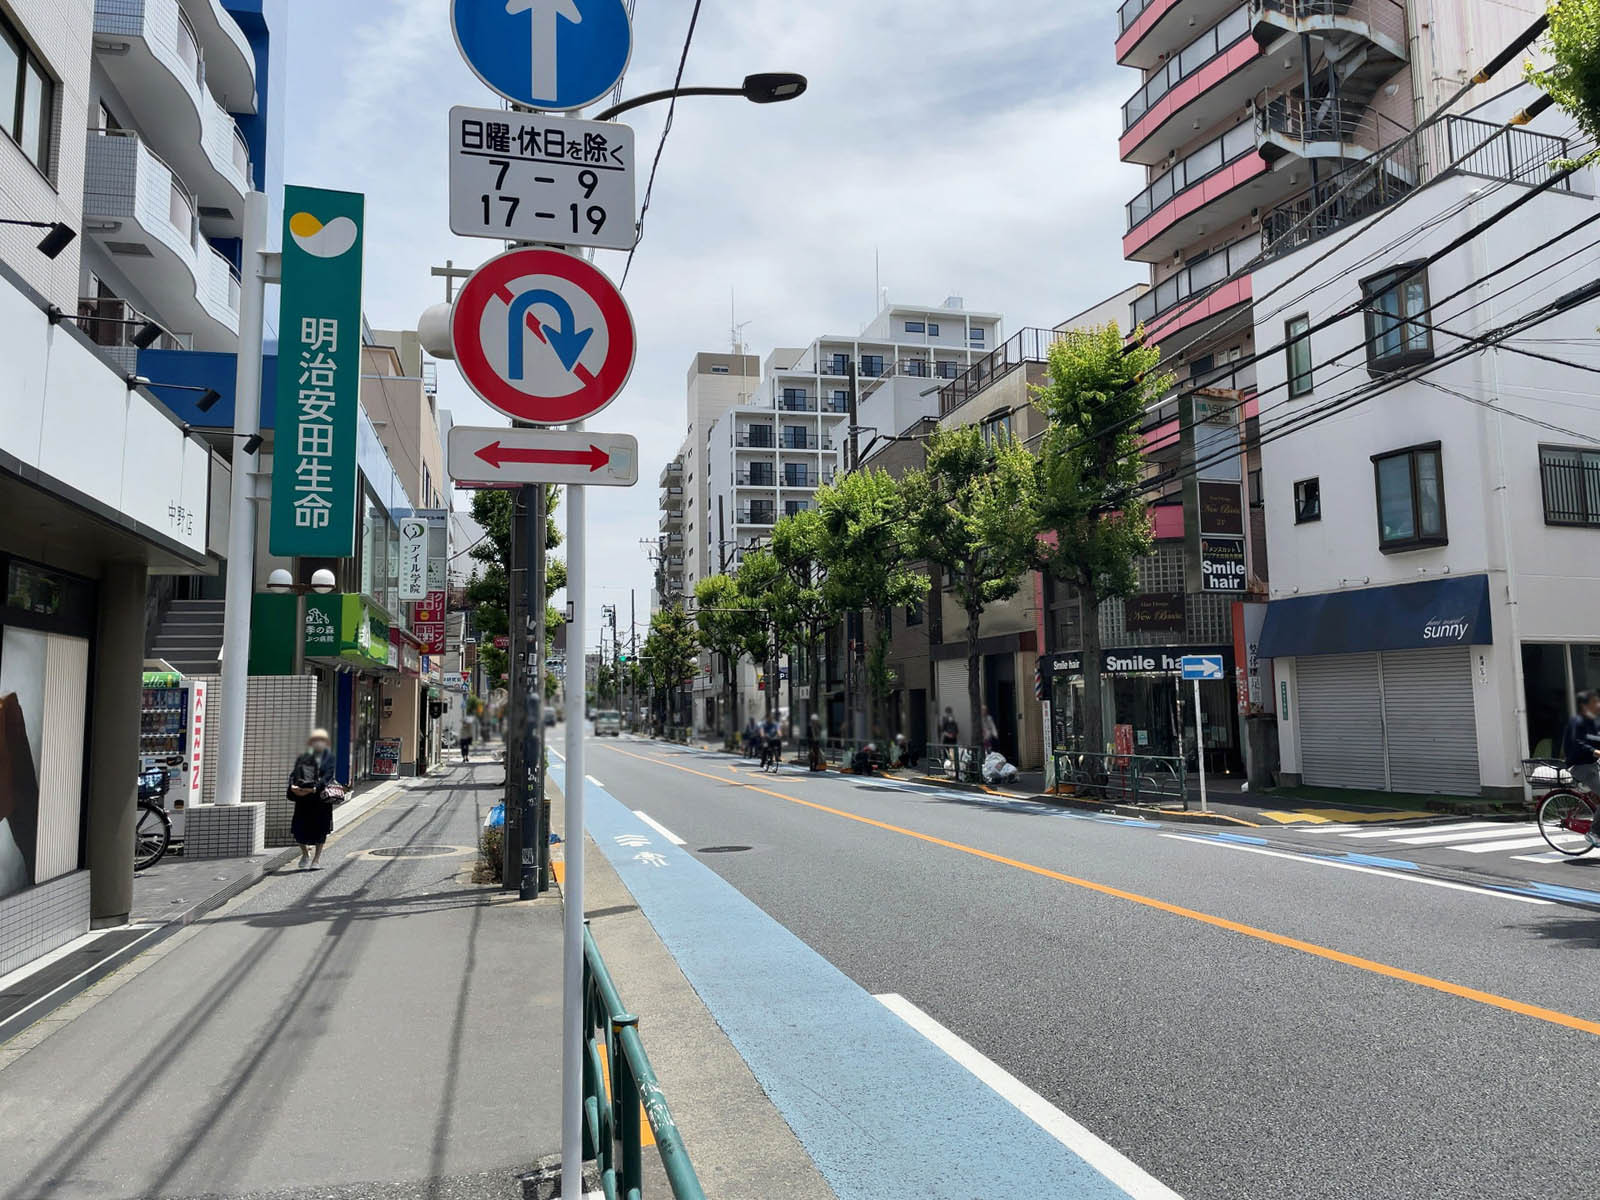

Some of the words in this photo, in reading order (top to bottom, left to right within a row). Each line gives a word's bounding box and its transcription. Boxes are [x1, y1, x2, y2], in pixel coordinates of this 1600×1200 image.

[462, 120, 623, 165] 日曜・休日を除く
[294, 317, 338, 529] 明治安田生命
[168, 499, 193, 536] 中野店
[410, 544, 421, 594] アイル学院
[1202, 560, 1245, 575] Smile
[1209, 576, 1240, 590] hair
[434, 593, 444, 652] クリーニング
[1423, 623, 1469, 640] sunny
[1053, 660, 1068, 671] Smile
[1069, 659, 1080, 670] hair
[1106, 655, 1156, 671] Smile
